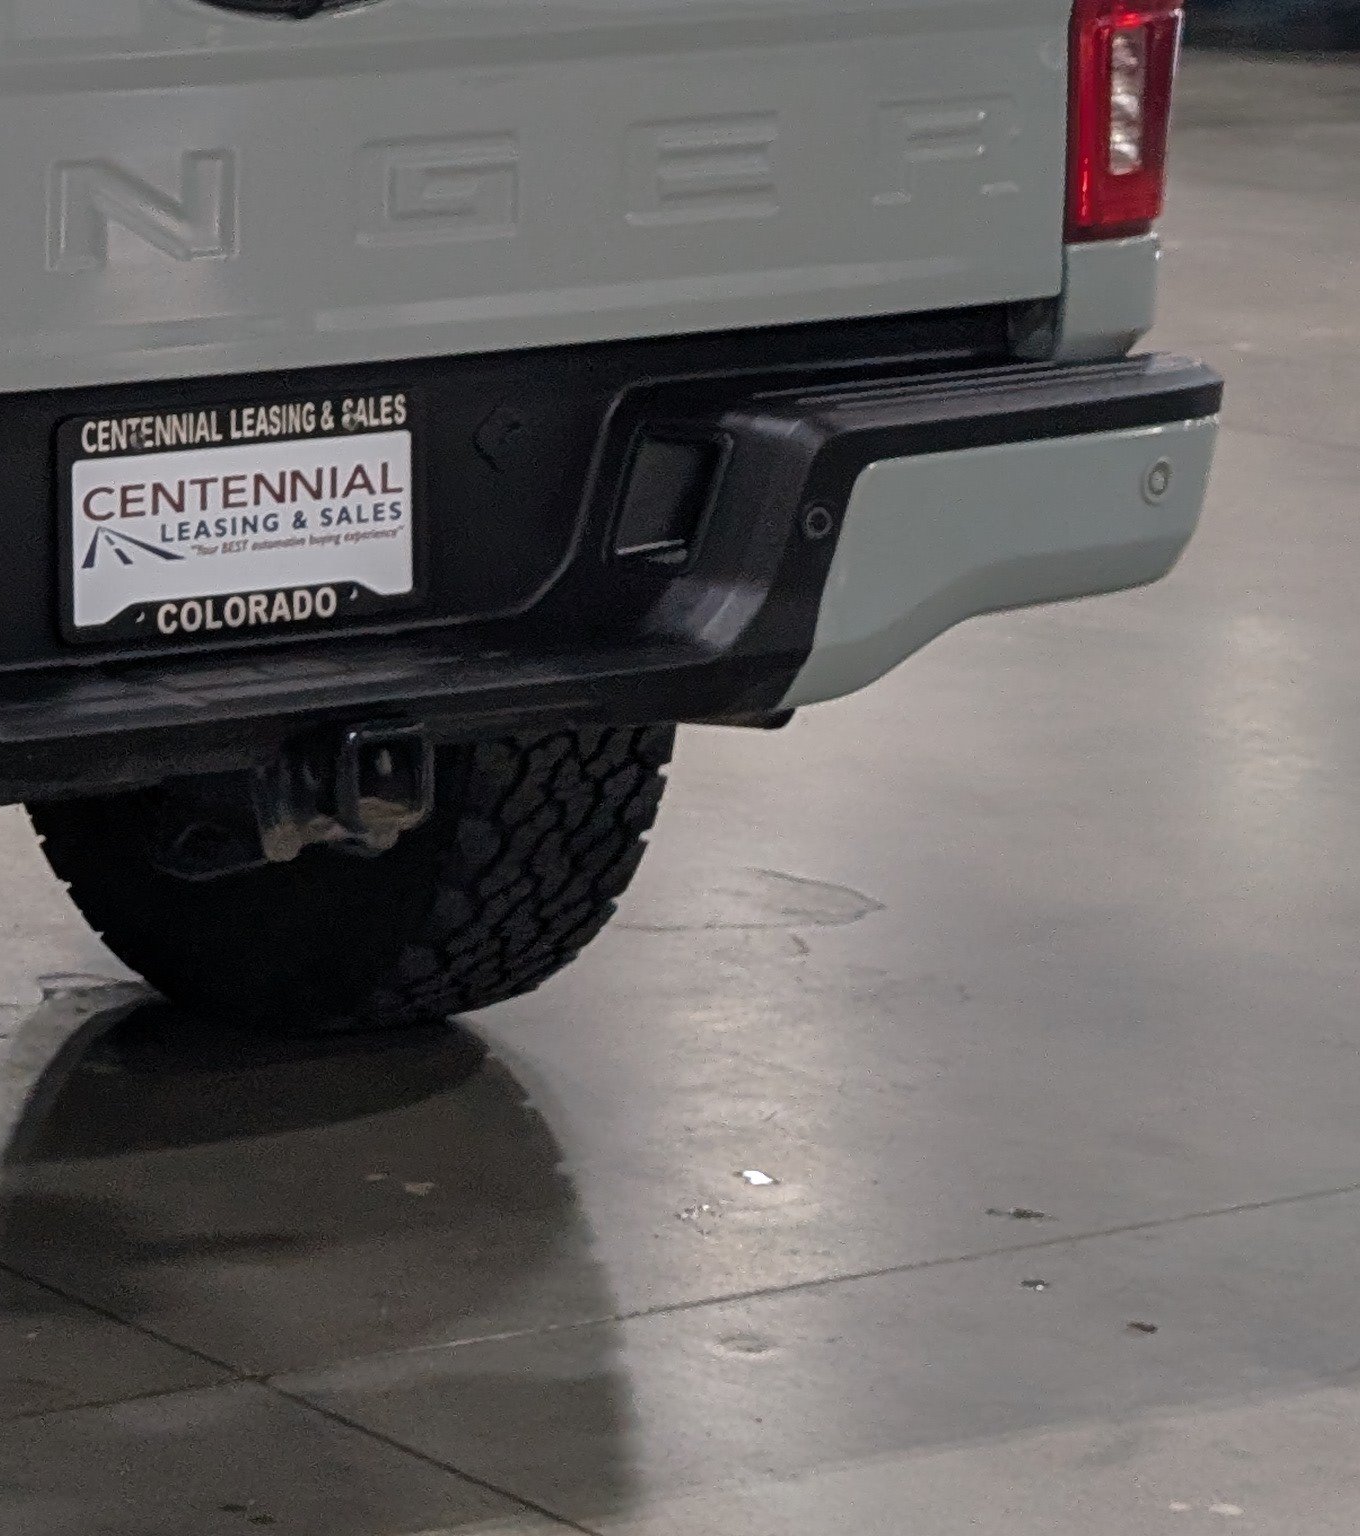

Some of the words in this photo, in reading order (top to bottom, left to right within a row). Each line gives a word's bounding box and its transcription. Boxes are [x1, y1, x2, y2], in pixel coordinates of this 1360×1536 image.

[81, 410, 223, 454] CENTENNIAL
[229, 401, 316, 440] LEASING
[320, 399, 335, 431] &
[341, 393, 408, 432] SALES
[82, 461, 404, 522] CENTENNIAL
[161, 512, 279, 543] LEASING
[292, 510, 307, 530] &
[320, 501, 403, 527] SALES
[156, 586, 338, 635] COLORADO
